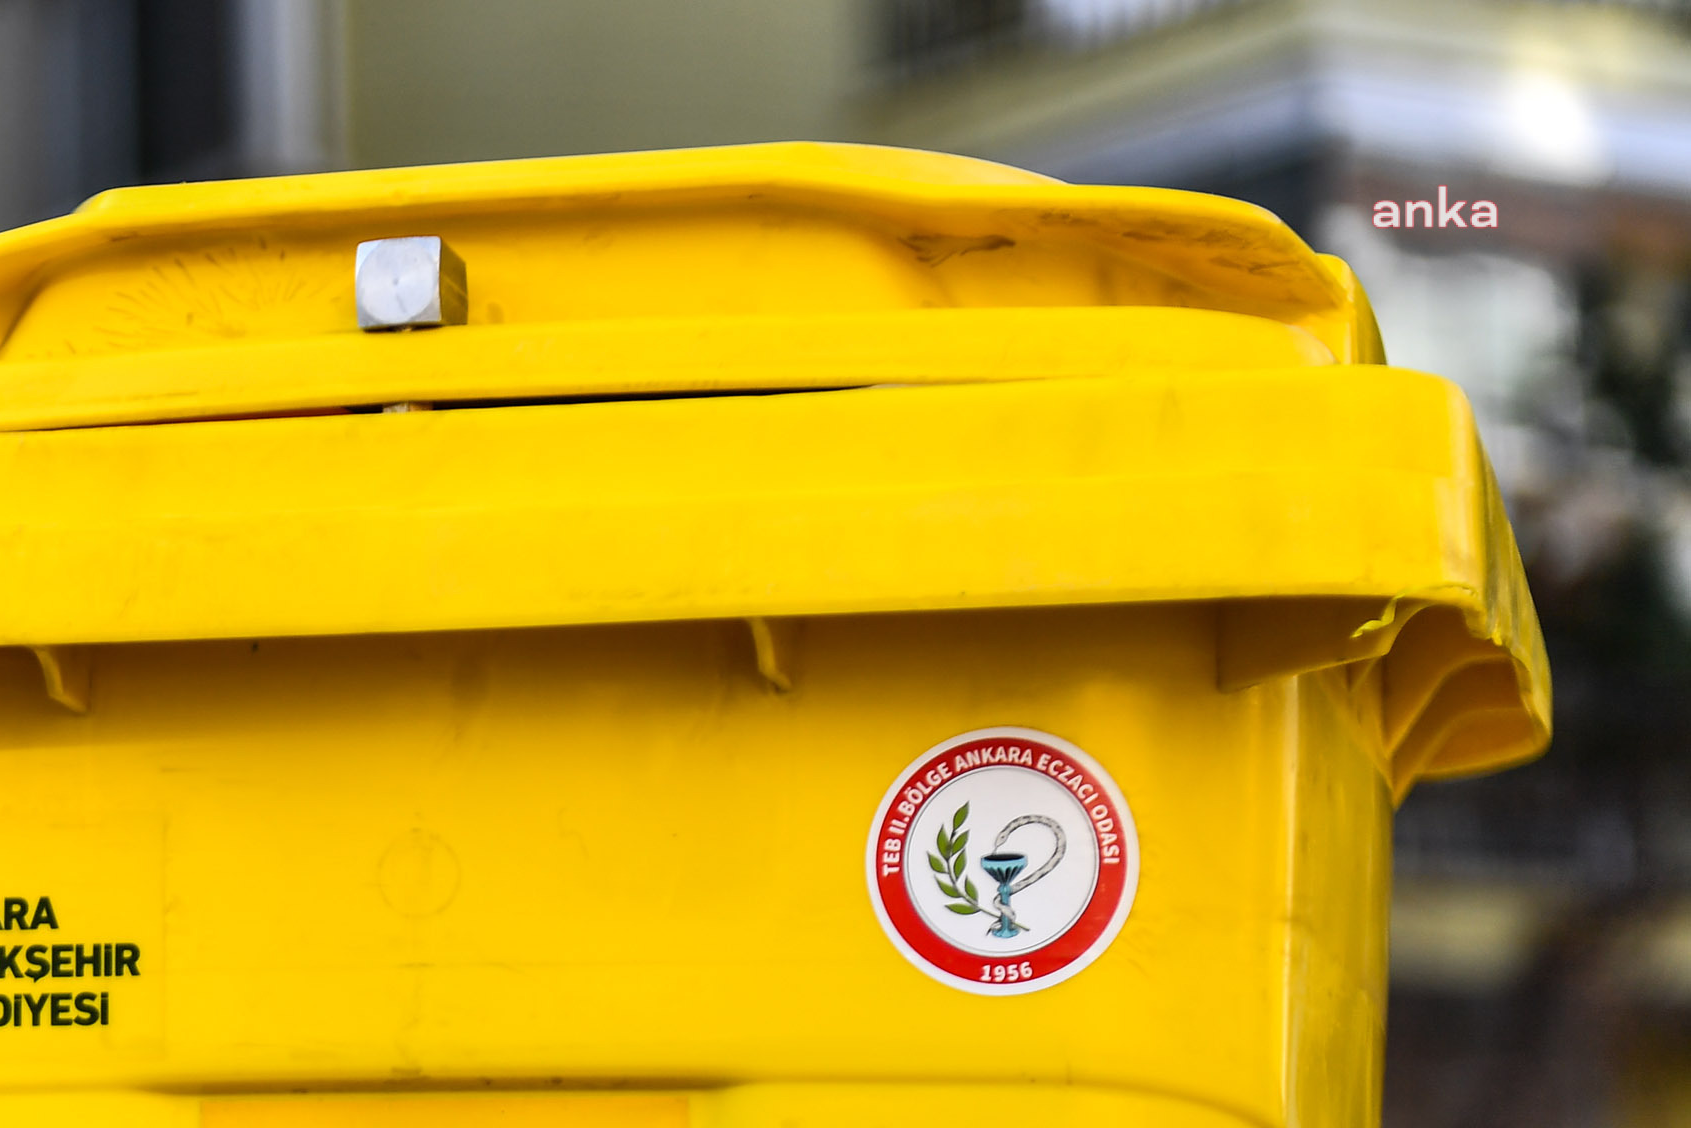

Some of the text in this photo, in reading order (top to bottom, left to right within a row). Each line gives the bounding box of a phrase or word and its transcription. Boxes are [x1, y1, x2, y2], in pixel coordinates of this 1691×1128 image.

[882, 838, 902, 877] TEB
[955, 746, 1033, 773] ANKARA
[1036, 753, 1099, 804] ECZACI
[1091, 804, 1120, 864] ODASI
[980, 961, 1034, 982] 1956
